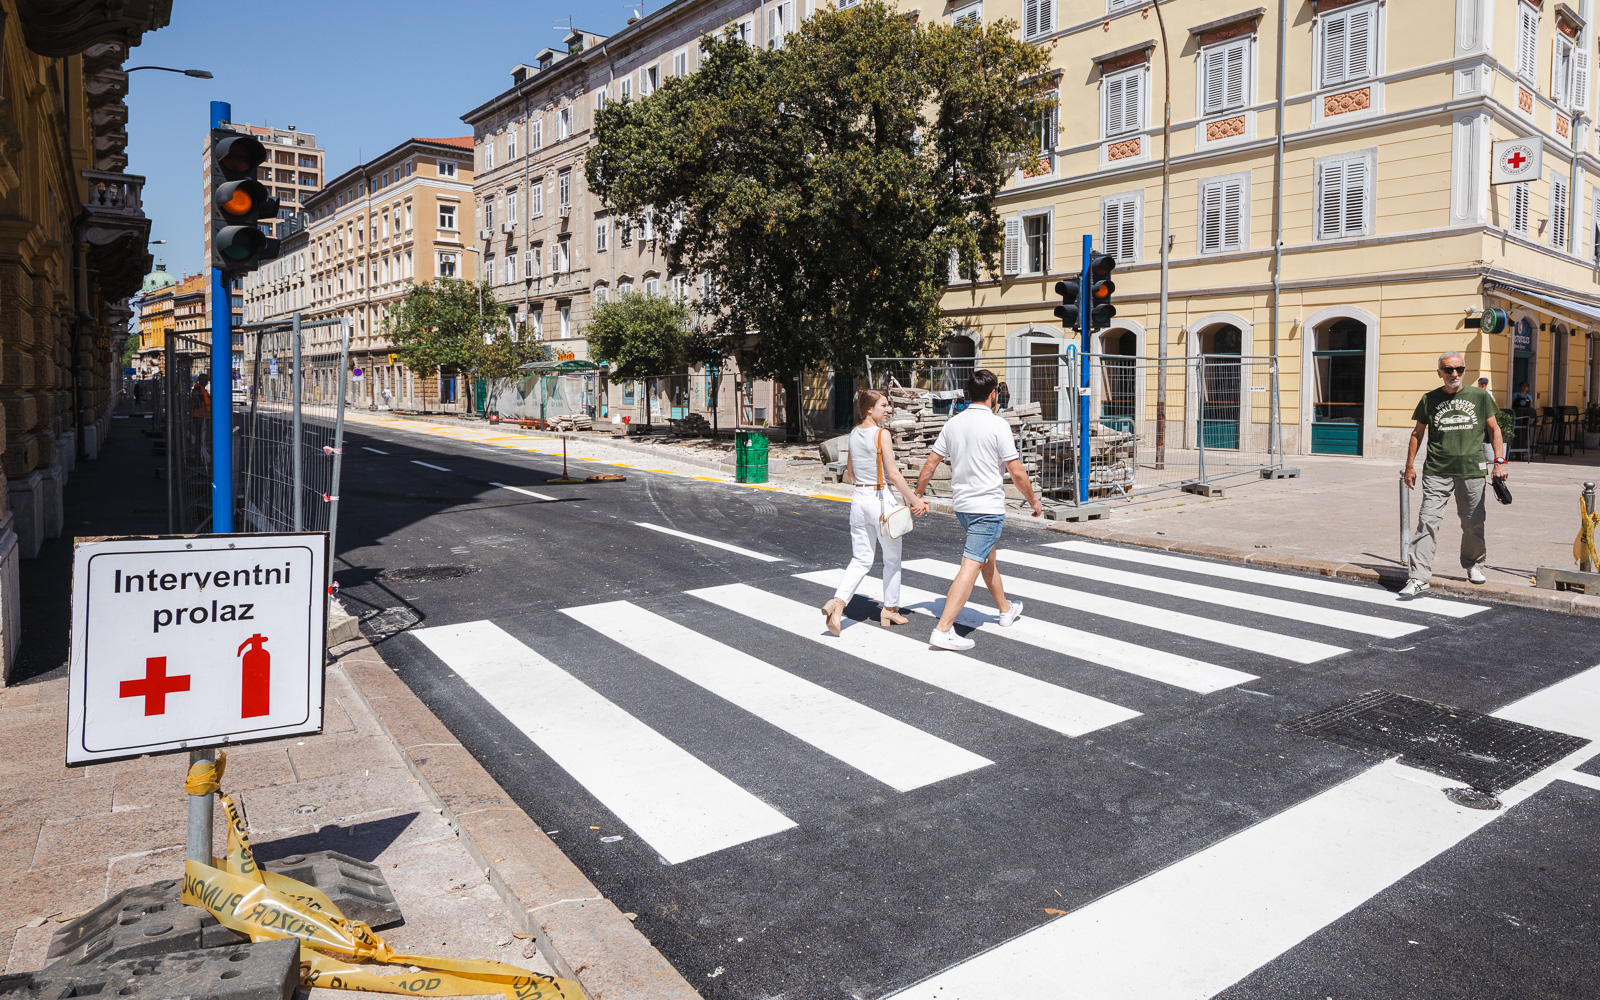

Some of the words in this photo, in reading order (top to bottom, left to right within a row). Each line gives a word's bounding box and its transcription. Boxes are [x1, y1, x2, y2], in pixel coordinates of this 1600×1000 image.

[1455, 404, 1478, 425] SPEEDWAY
[114, 562, 291, 594] Interventni
[153, 600, 255, 633] prolaz
